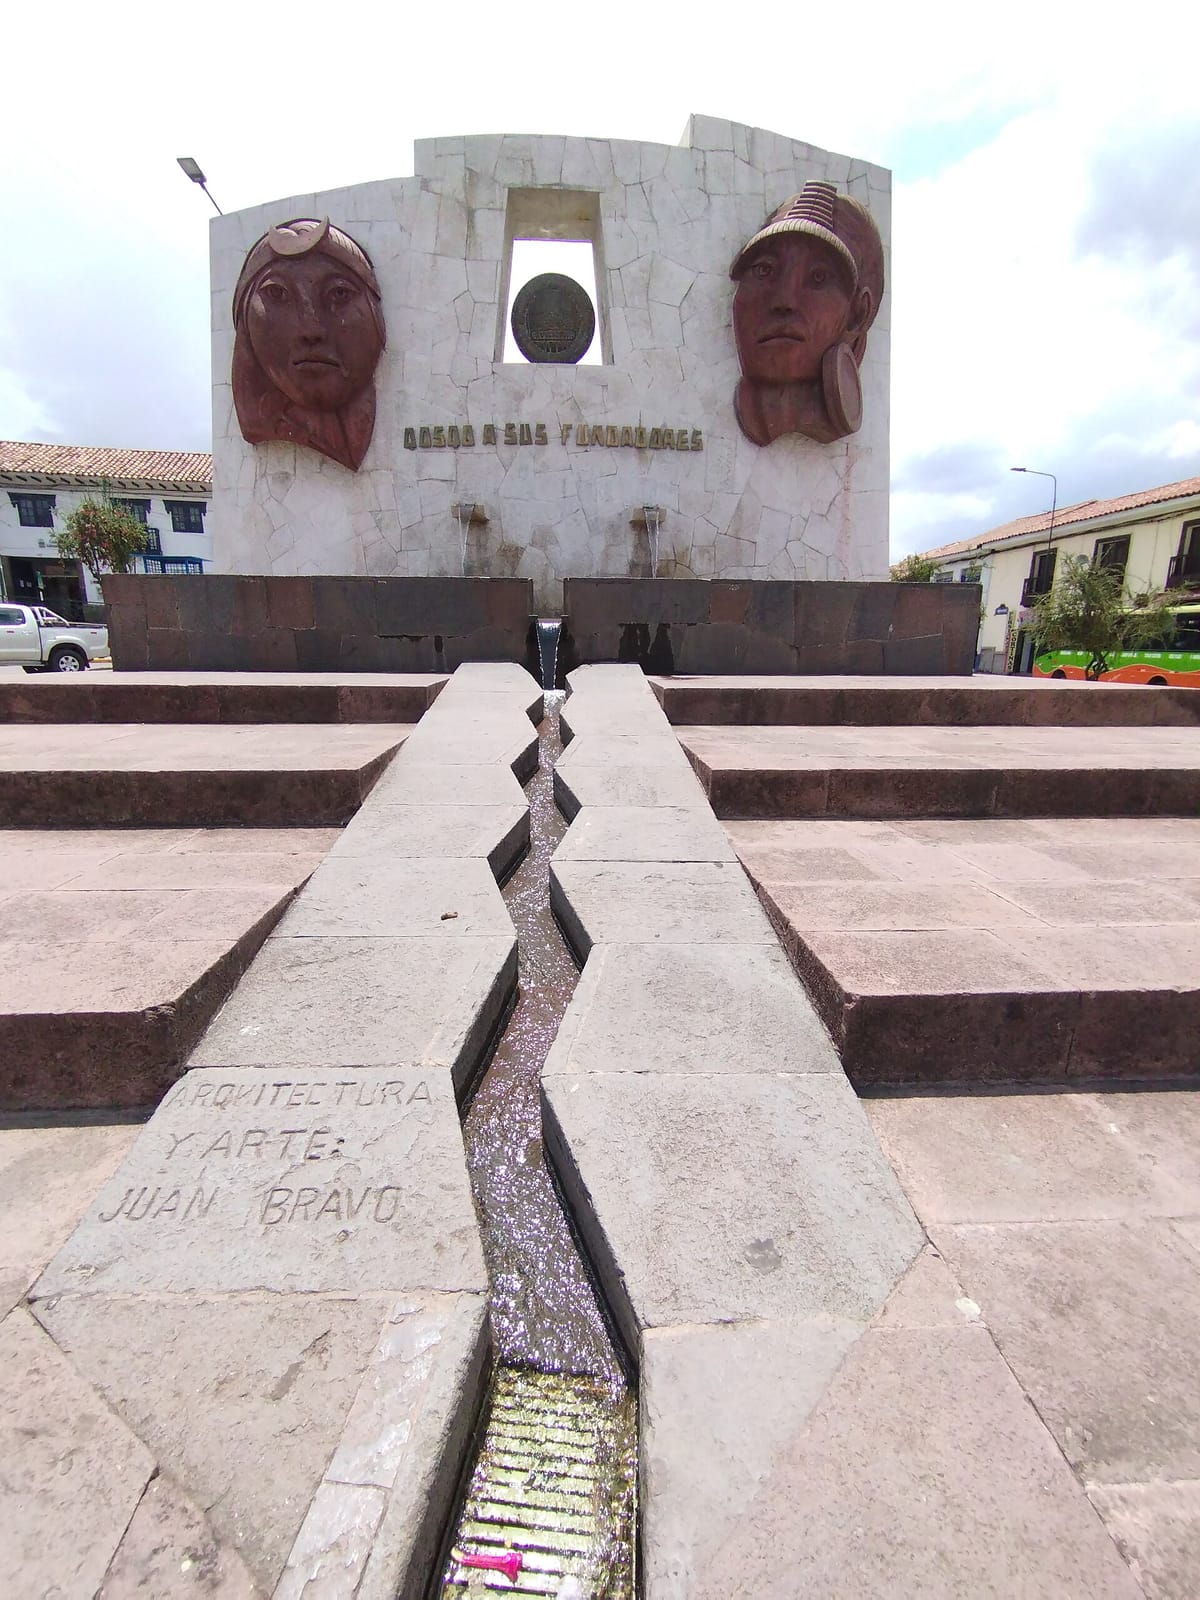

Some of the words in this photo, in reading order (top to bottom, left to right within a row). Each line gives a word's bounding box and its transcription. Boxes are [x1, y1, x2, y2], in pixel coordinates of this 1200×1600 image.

[403, 424, 475, 450] QOSQO
[483, 424, 497, 446] A
[504, 423, 548, 445] SUS
[561, 424, 703, 451] FUNDADORES
[165, 1080, 433, 1108] ARQUITECTURA
[165, 1132, 195, 1160] Y
[200, 1127, 345, 1160] ARTE:
[99, 1186, 219, 1222] JUAN
[259, 1185, 402, 1225] BRAVO
